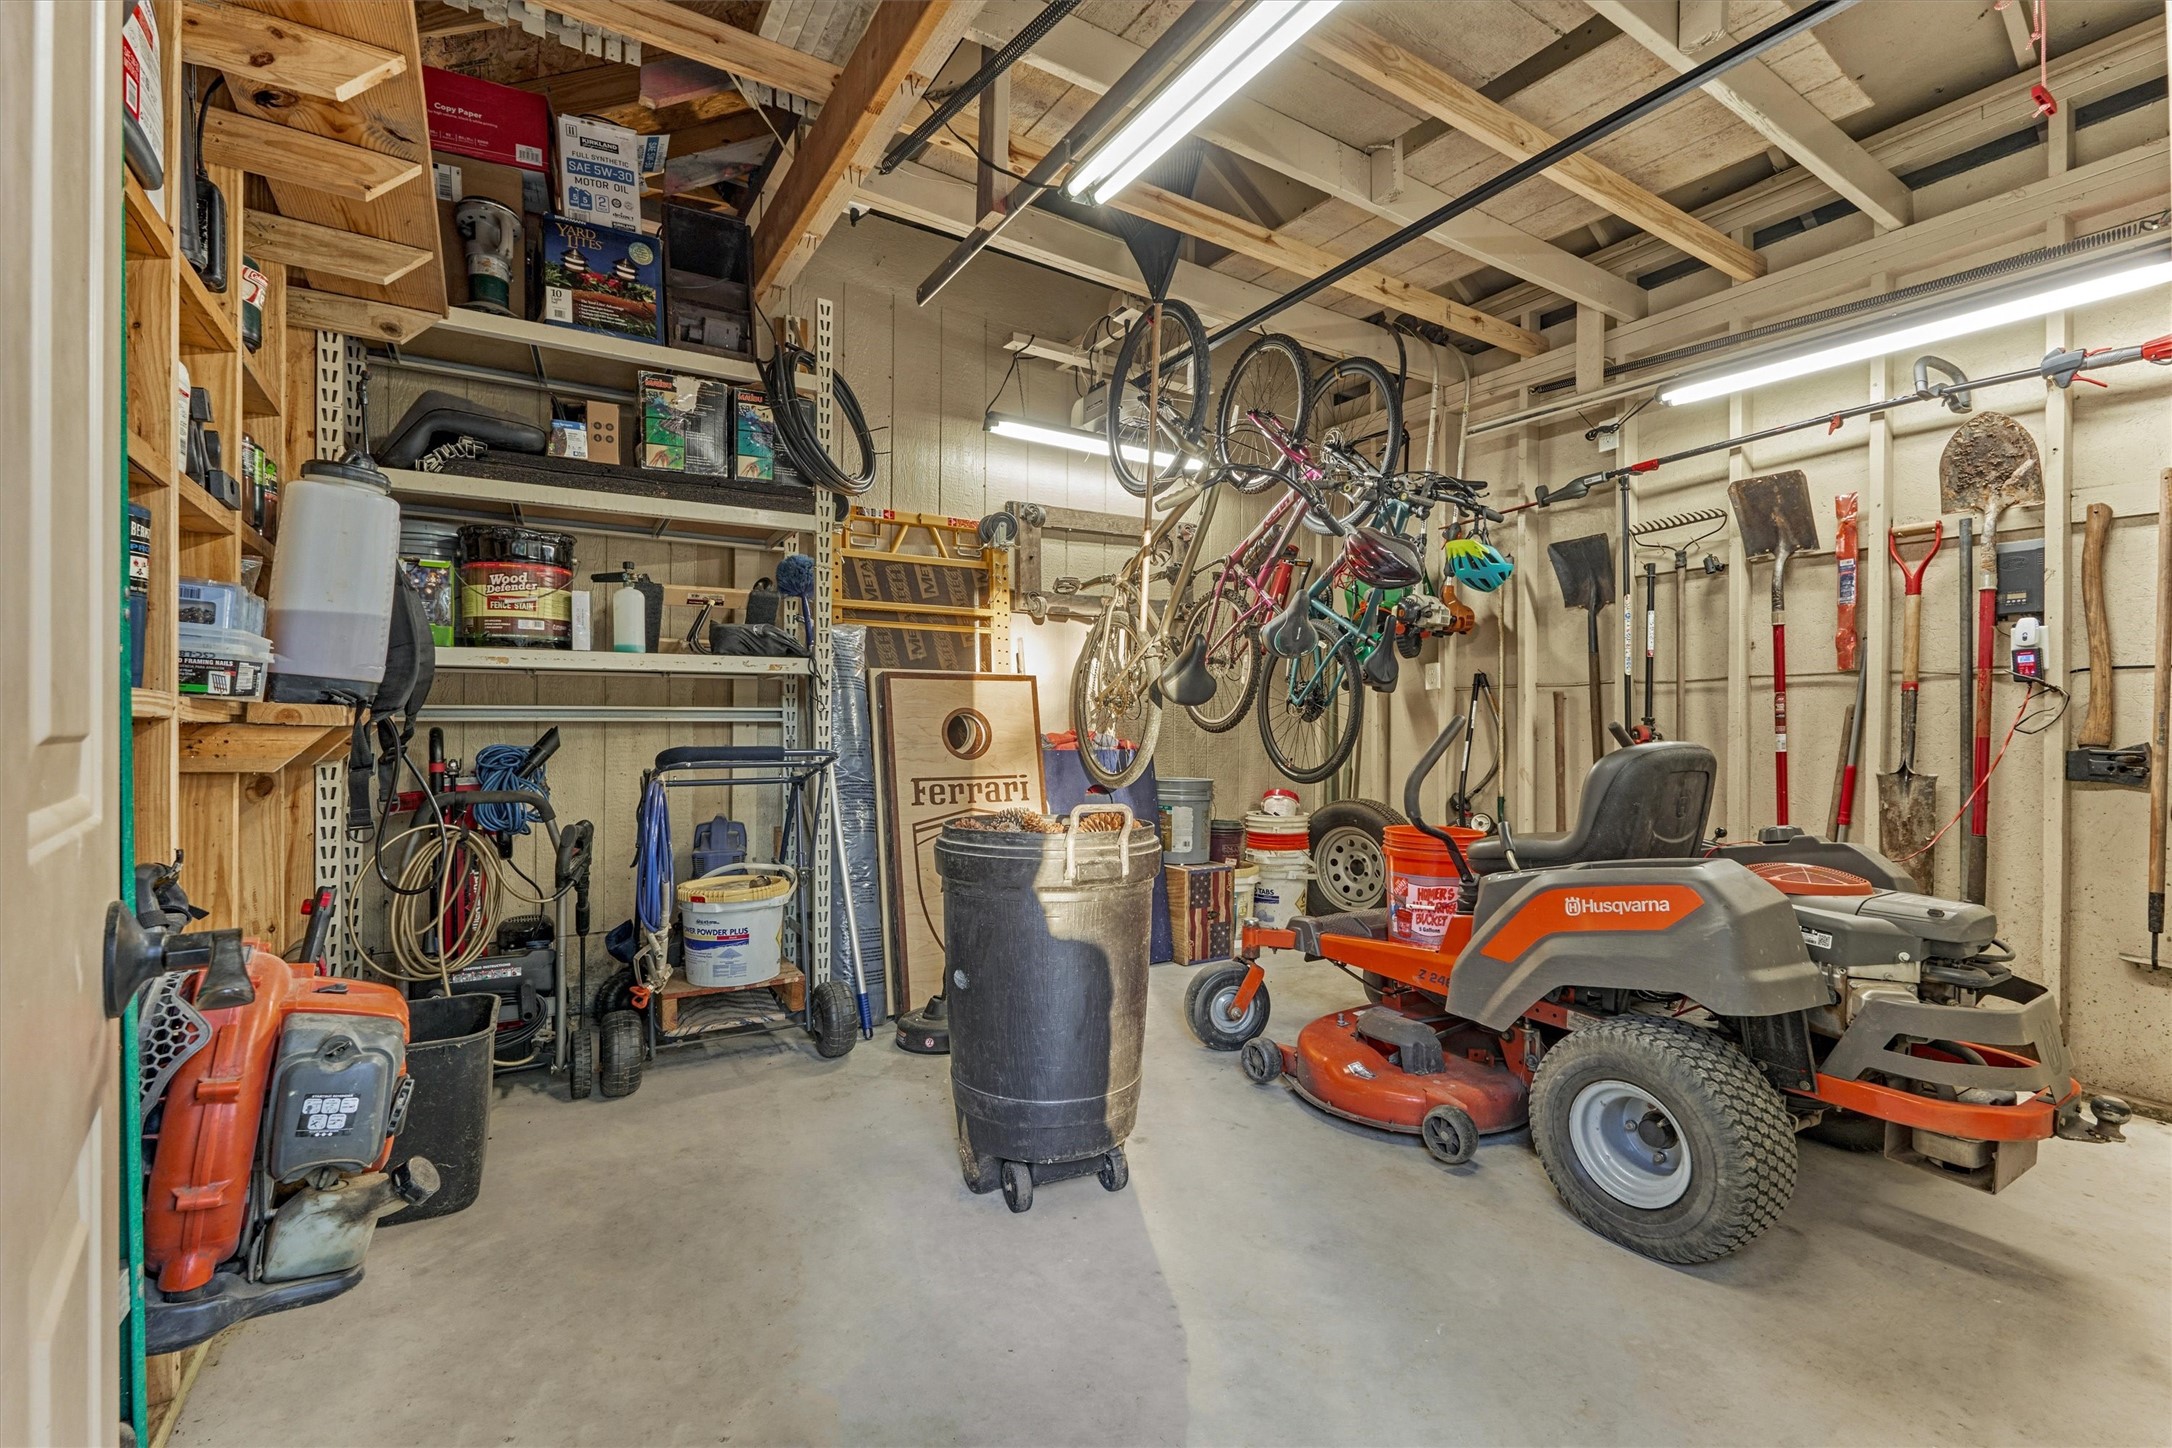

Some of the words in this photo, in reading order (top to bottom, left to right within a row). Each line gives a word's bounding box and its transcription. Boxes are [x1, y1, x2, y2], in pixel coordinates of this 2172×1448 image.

[434, 102, 456, 114] Copy
[458, 107, 482, 119] Paper
[582, 138, 618, 151] KIRKLAND
[571, 150, 589, 159] FULL
[590, 154, 629, 168] SYNTHETIC
[568, 160, 590, 174] SAE
[594, 166, 633, 183] 5W-30
[574, 176, 609, 190] MOTOR
[613, 183, 629, 195] OIL
[583, 196, 588, 204] 5
[598, 196, 606, 208] 2
[556, 222, 596, 240] YARD
[567, 235, 604, 250] LITES
[551, 289, 562, 299] 10
[489, 572, 528, 586] Wood
[486, 582, 538, 594] Defender
[490, 600, 512, 609] FENCE
[514, 601, 534, 610] STAIN
[184, 658, 214, 666] FRAMING
[910, 774, 1030, 806] Ferrari
[1258, 887, 1275, 896] TABS
[1417, 888, 1455, 900] HOMER'S
[1581, 899, 1670, 915] Husqvarna
[1415, 913, 1449, 926] BUCKET
[696, 928, 727, 936] POWDER
[729, 927, 749, 935] PLUS
[1418, 969, 1427, 980] Z
